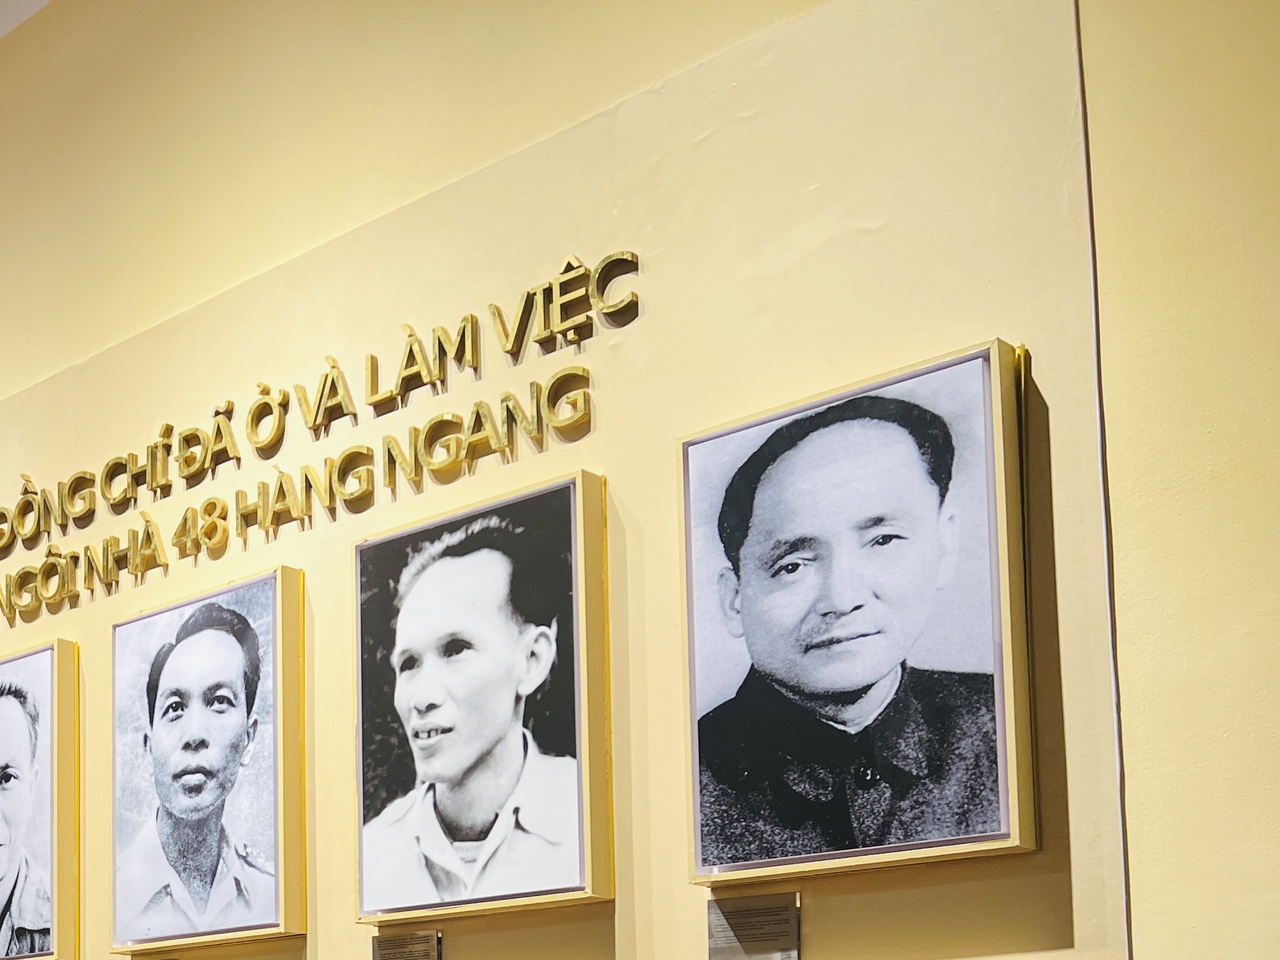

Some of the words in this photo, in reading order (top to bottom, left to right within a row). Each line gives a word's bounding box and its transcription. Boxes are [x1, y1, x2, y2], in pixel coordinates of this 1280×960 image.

[84, 510, 169, 589] NHÀ
[172, 497, 229, 555] 48
[235, 445, 375, 538] HÀNG
[383, 366, 591, 488] NGANG
[100, 423, 174, 505] CHÍ
[174, 400, 241, 479] ĐÃ
[246, 382, 290, 450] Ở
[294, 356, 358, 430] VÀ
[366, 313, 478, 406] LÀM
[488, 251, 639, 353] VIỆC
